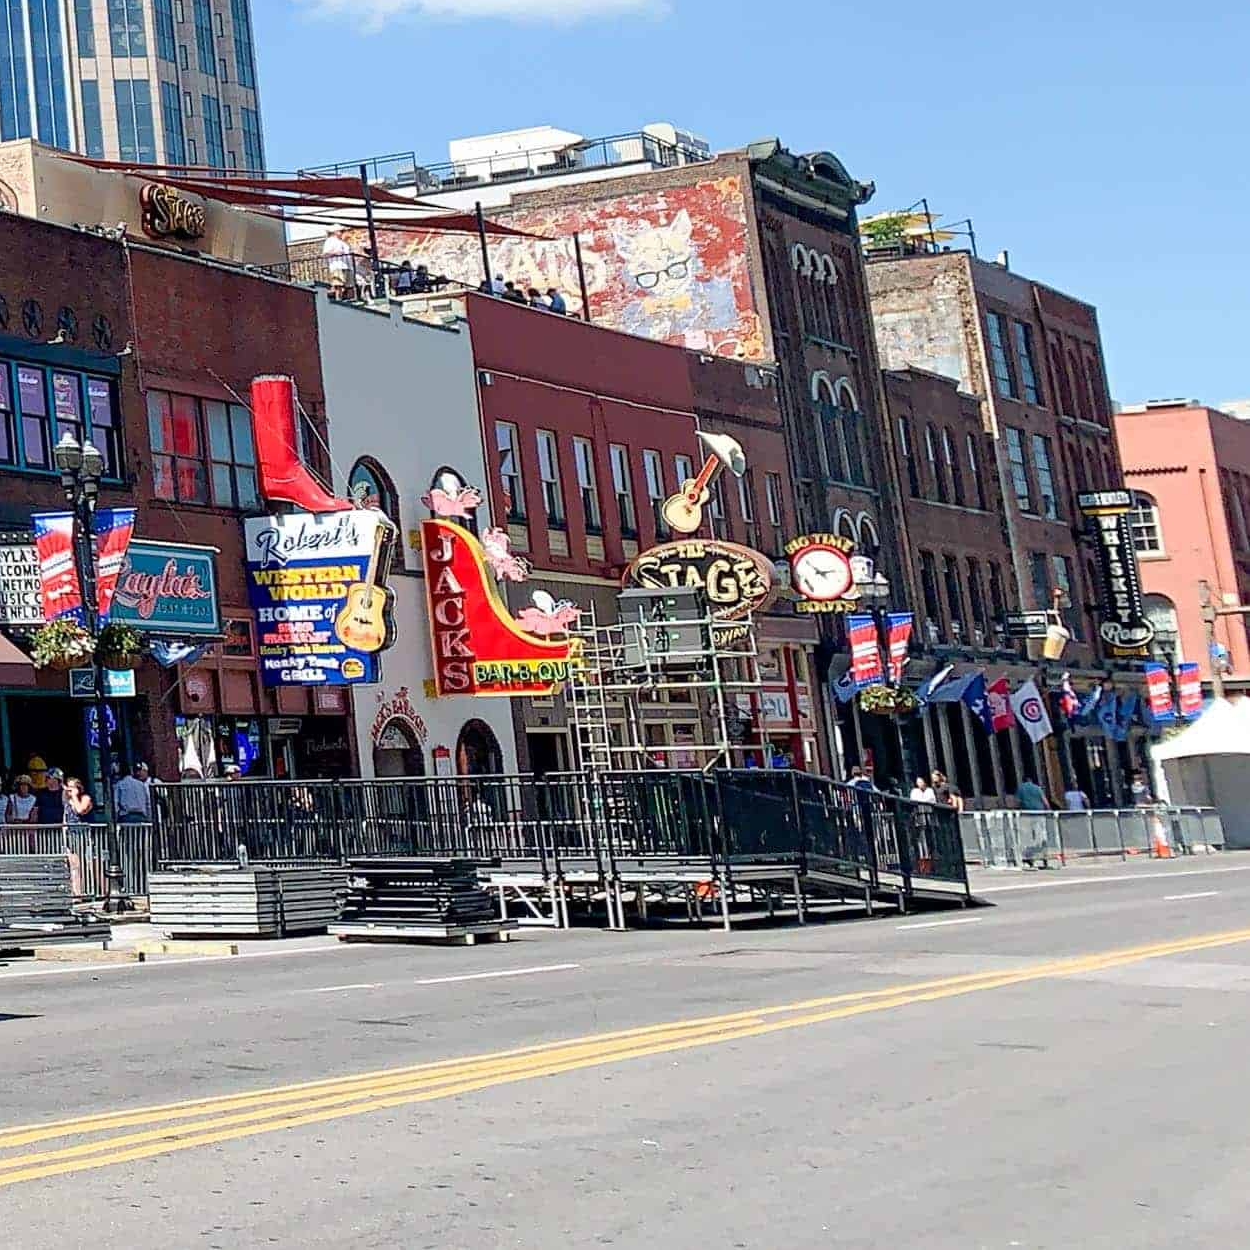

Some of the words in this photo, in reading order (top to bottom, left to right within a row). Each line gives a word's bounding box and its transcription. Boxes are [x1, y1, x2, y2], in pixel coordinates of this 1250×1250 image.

[256, 517, 360, 567] Robert's
[677, 546, 707, 559] THE
[785, 534, 811, 555] BIG
[812, 533, 855, 554] TIME
[253, 565, 360, 586] WESTERN
[631, 555, 768, 604] STAGE
[1098, 515, 1132, 623] WHISKEY
[2, 579, 41, 591] NETWO
[269, 583, 347, 601] WORLD
[10, 606, 29, 618] NFL
[258, 605, 323, 622] HOME
[324, 603, 338, 624] of
[795, 600, 857, 613] BOOTS
